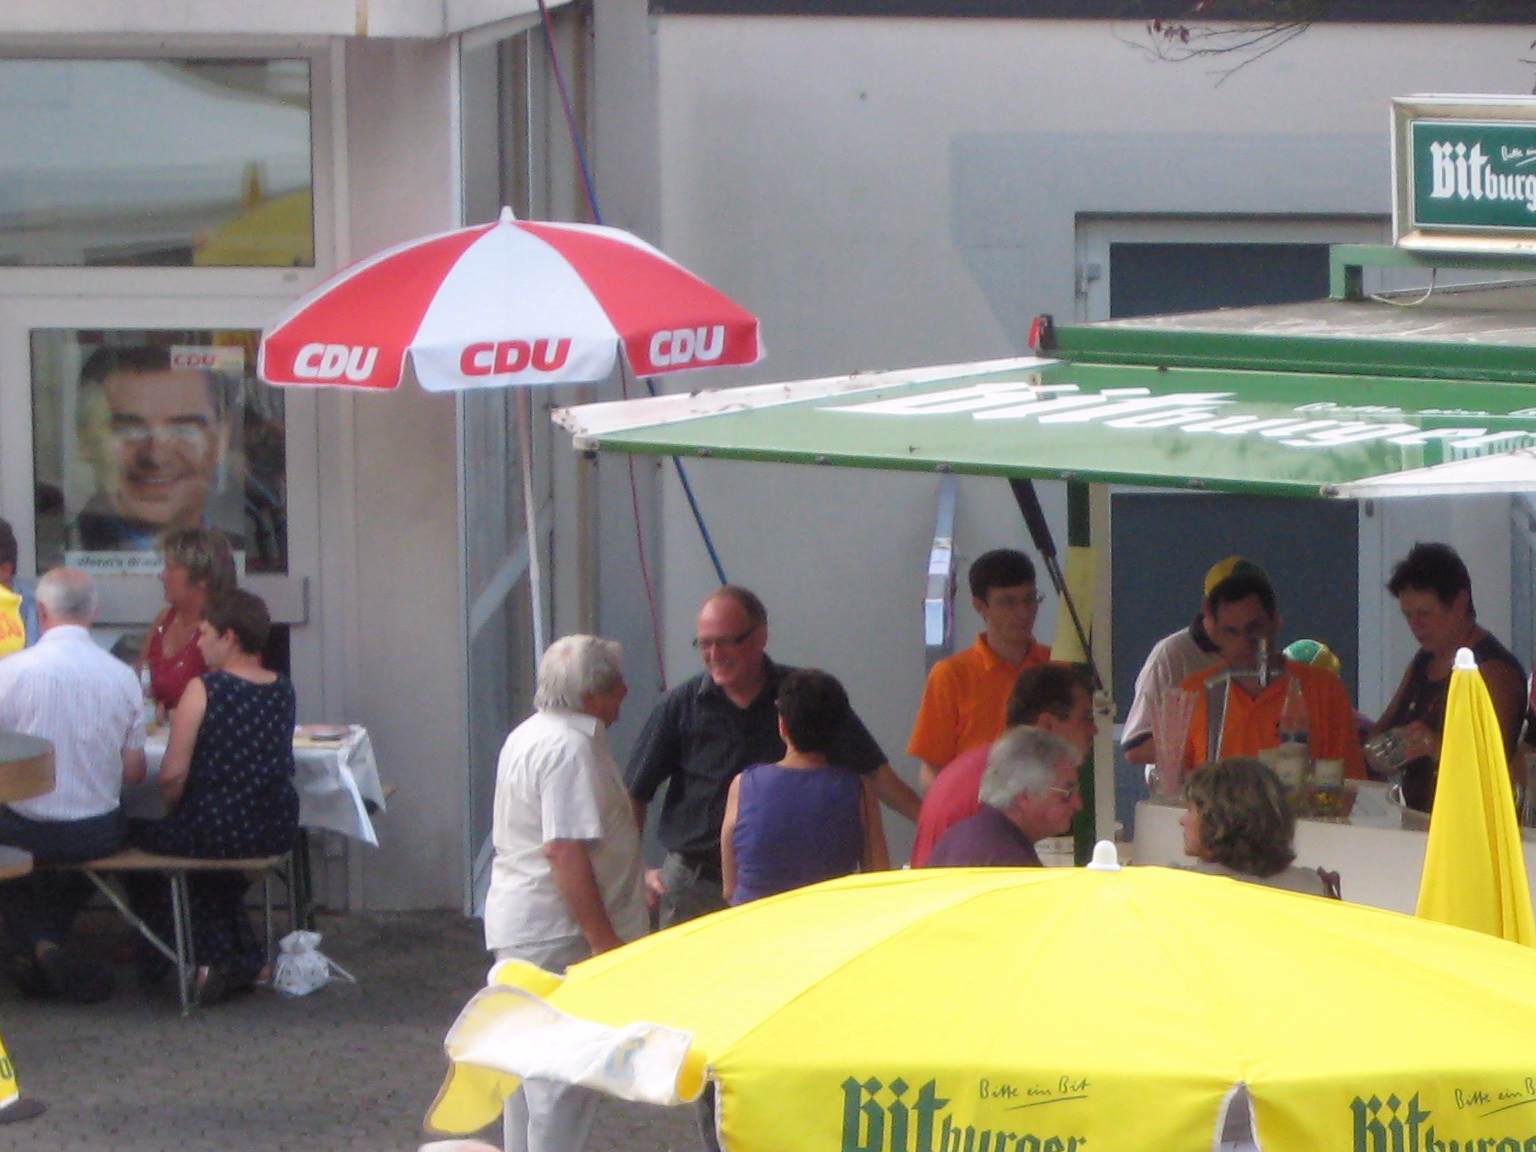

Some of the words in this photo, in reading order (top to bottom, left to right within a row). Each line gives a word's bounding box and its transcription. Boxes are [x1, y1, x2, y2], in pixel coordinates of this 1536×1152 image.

[292, 342, 379, 381] CDU
[458, 338, 572, 376] CDU
[649, 325, 725, 368] CDU
[1058, 1075, 1090, 1094] Bit
